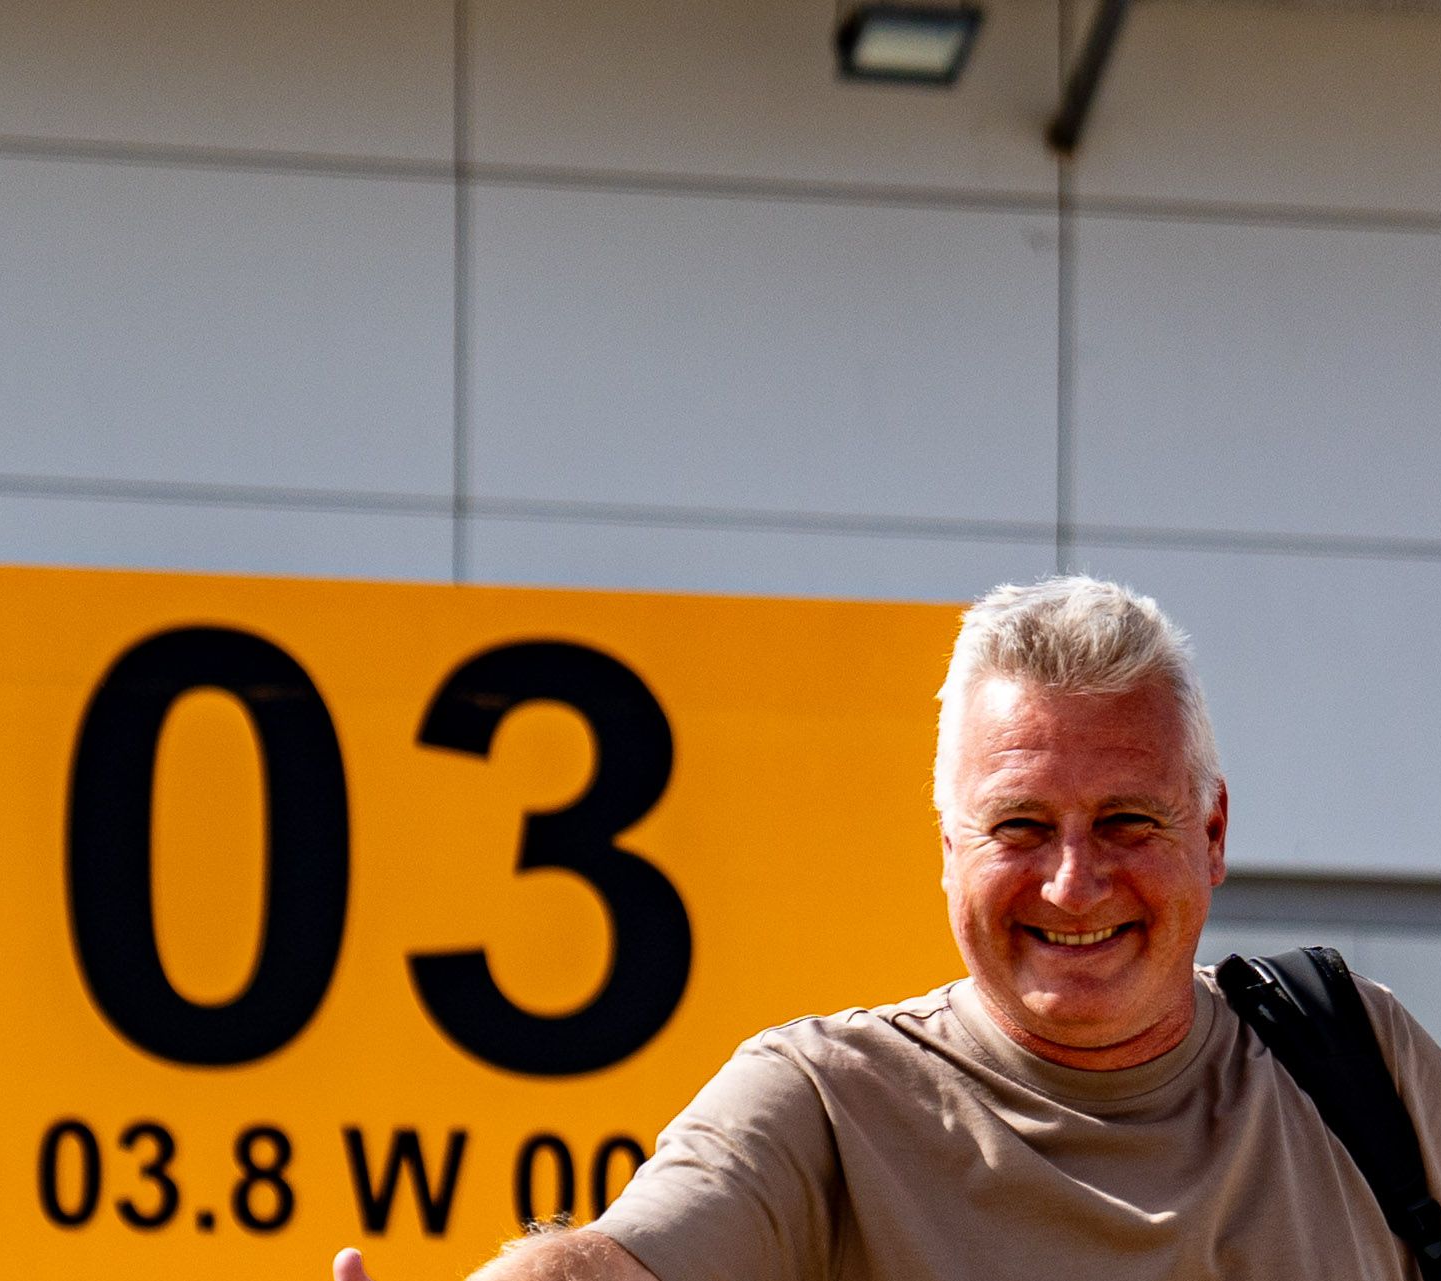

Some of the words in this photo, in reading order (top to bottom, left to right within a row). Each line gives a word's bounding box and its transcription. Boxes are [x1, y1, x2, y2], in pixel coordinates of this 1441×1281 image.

[62, 622, 695, 1081] 03
[36, 1117, 298, 1235] 03.8
[342, 1126, 470, 1238] W
